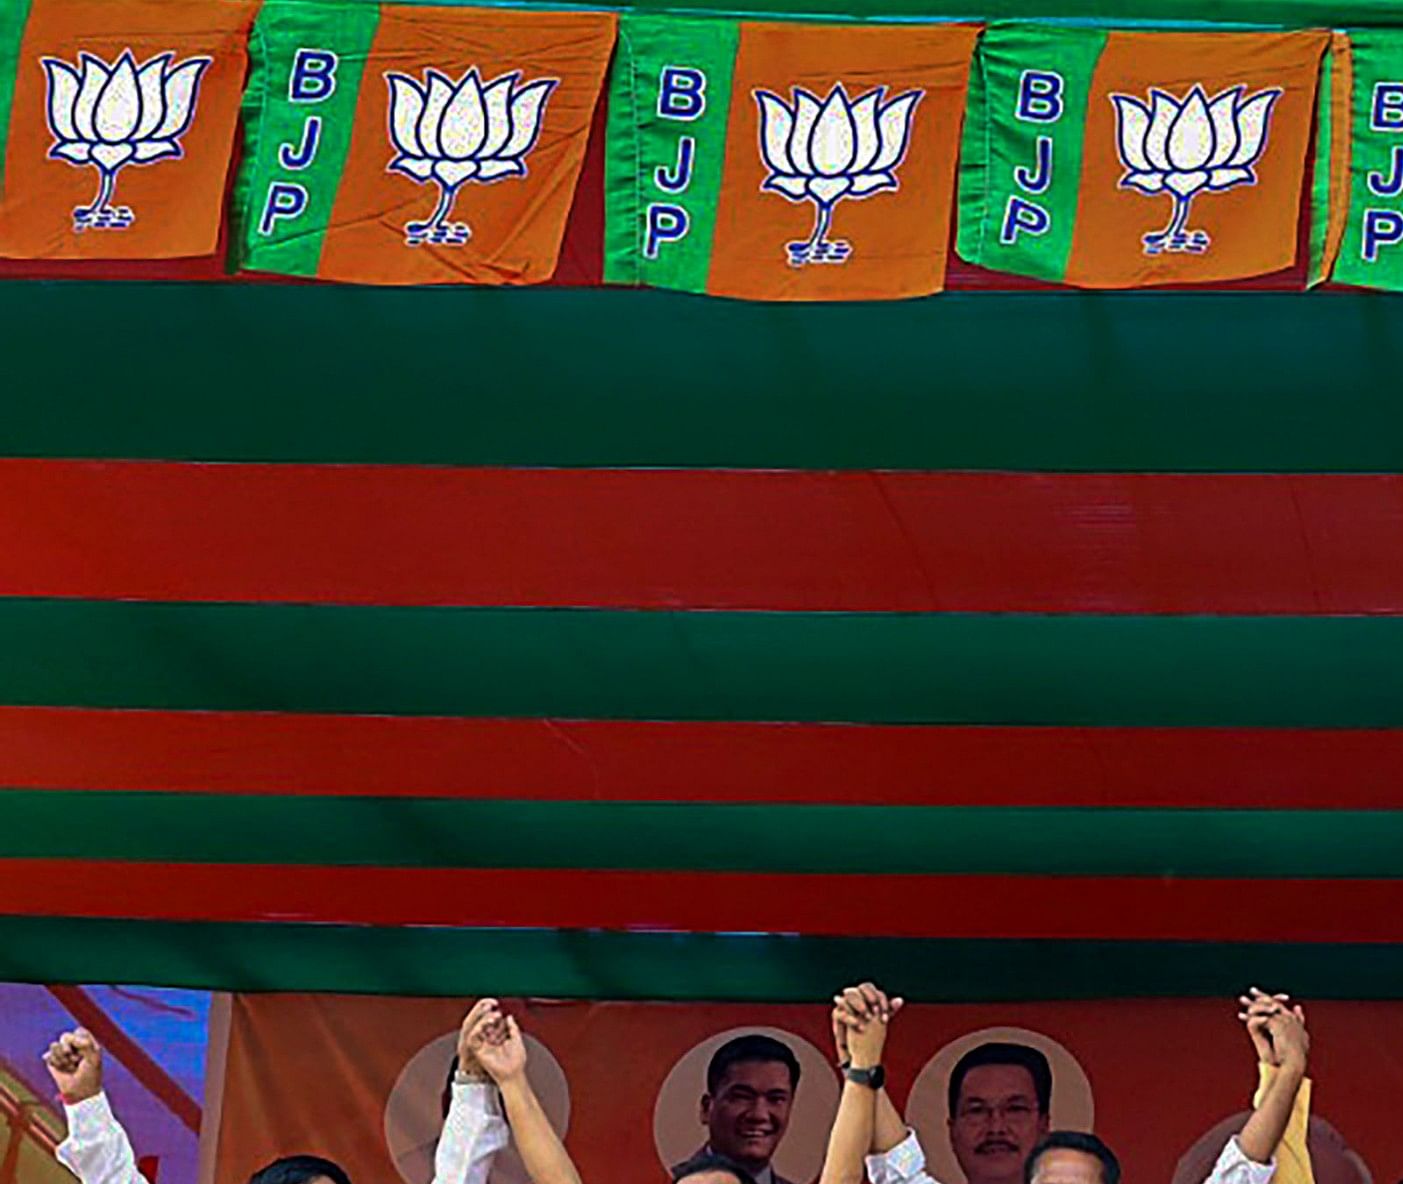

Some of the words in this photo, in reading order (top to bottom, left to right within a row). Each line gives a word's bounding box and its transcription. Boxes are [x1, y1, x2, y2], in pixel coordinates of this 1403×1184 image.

[263, 51, 337, 233] BJP
[646, 68, 704, 255] BJP
[1003, 72, 1062, 242] BJP
